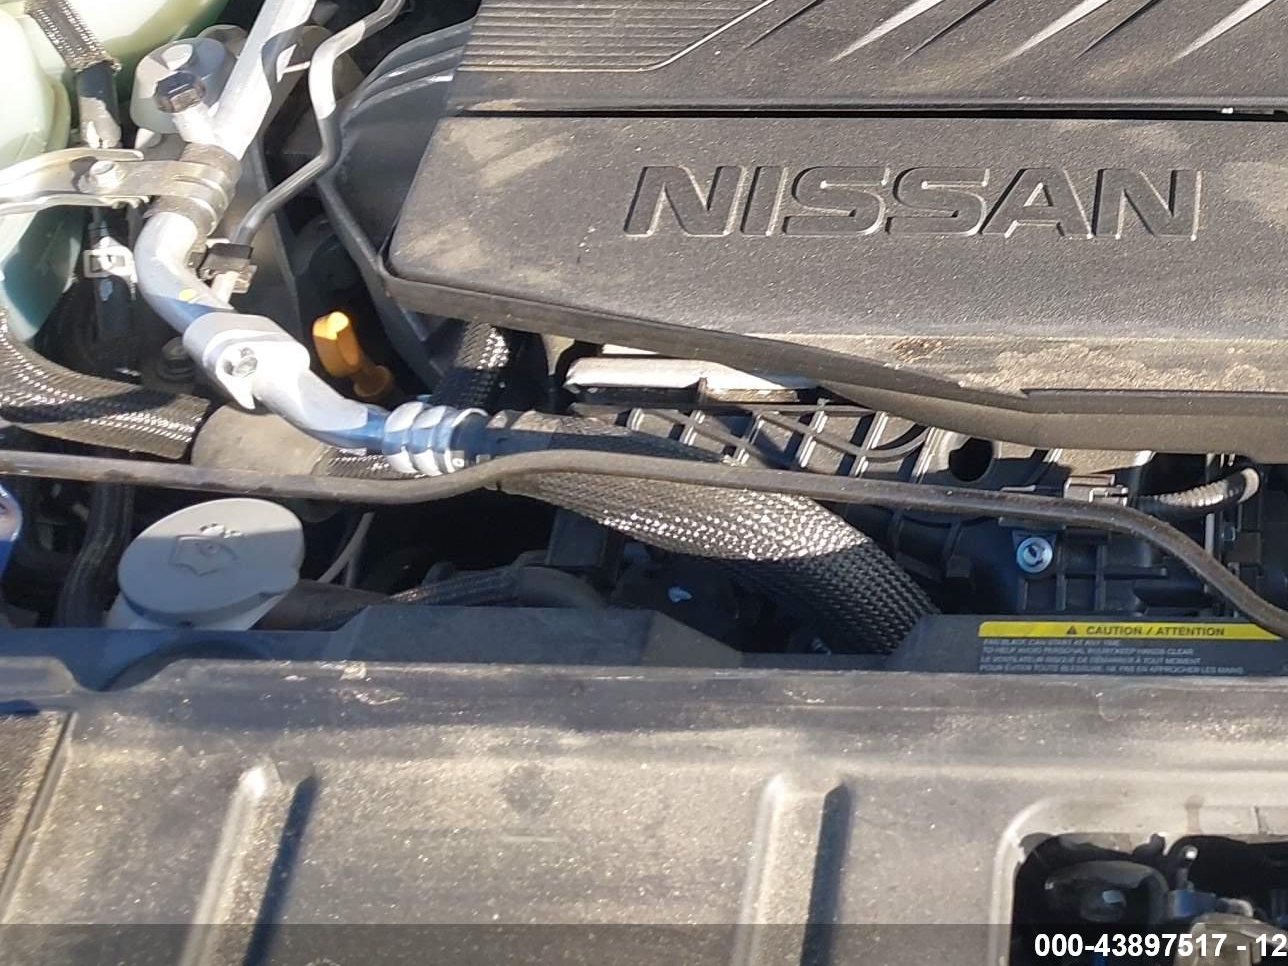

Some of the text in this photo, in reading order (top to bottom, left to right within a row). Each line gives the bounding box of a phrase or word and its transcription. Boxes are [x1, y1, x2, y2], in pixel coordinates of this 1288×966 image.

[624, 165, 1202, 240] NISSAN
[1085, 626, 1225, 637] CAUTION / ATTENTION
